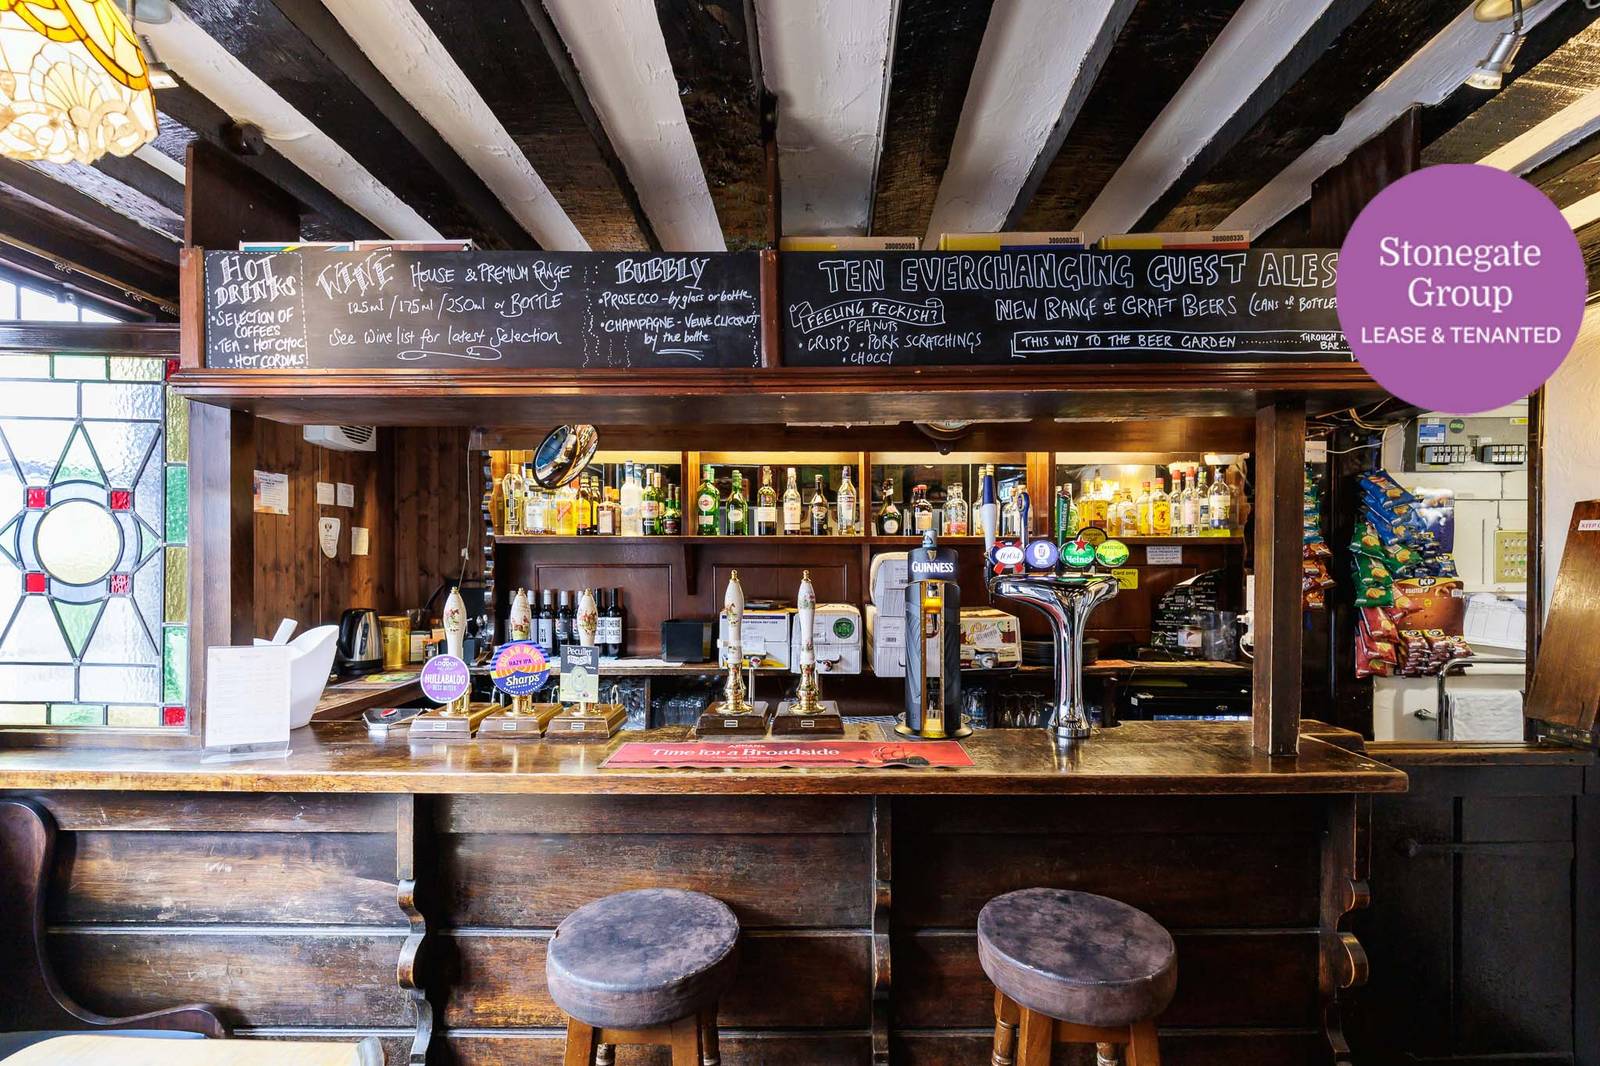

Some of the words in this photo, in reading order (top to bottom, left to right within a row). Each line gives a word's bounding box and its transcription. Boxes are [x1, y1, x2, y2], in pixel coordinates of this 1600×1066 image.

[220, 253, 278, 286] HOT
[316, 246, 396, 300] WINE
[410, 262, 456, 292] HOUSE
[532, 260, 573, 291] RANGE
[615, 256, 711, 290] BUBBLY
[818, 258, 885, 293] TEN
[900, 254, 1134, 292] EVERCHANGING
[1147, 252, 1248, 292] GUEST
[1258, 252, 1338, 288] ALES
[214, 275, 297, 309] DRINKS
[602, 291, 658, 310] PROSECCO
[681, 290, 704, 310] glass
[708, 293, 720, 302] or
[720, 289, 752, 301] bottle
[500, 292, 564, 318] BOTTLE
[807, 300, 866, 328] FEELING
[871, 300, 938, 324] PECKISH?
[995, 298, 1038, 320] NEW
[1044, 296, 1097, 320] RANGE
[1182, 294, 1237, 317] BEERS
[216, 310, 274, 326] SELECTION
[278, 306, 294, 323] OF
[604, 316, 675, 333] CHAMPAGNE
[848, 319, 898, 333] PEANUTS
[234, 324, 281, 338] COFFEES
[329, 328, 356, 346] See
[396, 325, 415, 345] list
[420, 328, 440, 350] for
[448, 324, 486, 345] latest
[644, 332, 658, 351] by
[663, 331, 681, 342] the
[684, 330, 710, 343] bottle
[1021, 336, 1049, 348] THIS
[1054, 334, 1079, 348] WAY
[1086, 334, 1101, 346] TO
[1108, 334, 1131, 347] THE
[1138, 335, 1172, 348] BEER
[1181, 335, 1236, 349] GARDEN
[1300, 332, 1336, 342] THROUGH
[218, 337, 240, 353] TEA
[254, 338, 275, 352] HOT
[274, 336, 305, 352] CHOC
[807, 334, 851, 351] CRISPS
[868, 333, 900, 350] PORK
[904, 332, 982, 354] SCRATCHINGS
[234, 354, 260, 368] HOT
[850, 352, 894, 365] CHOCCY
[912, 561, 954, 572] GUINNESS
[743, 748, 840, 756] Broadside
